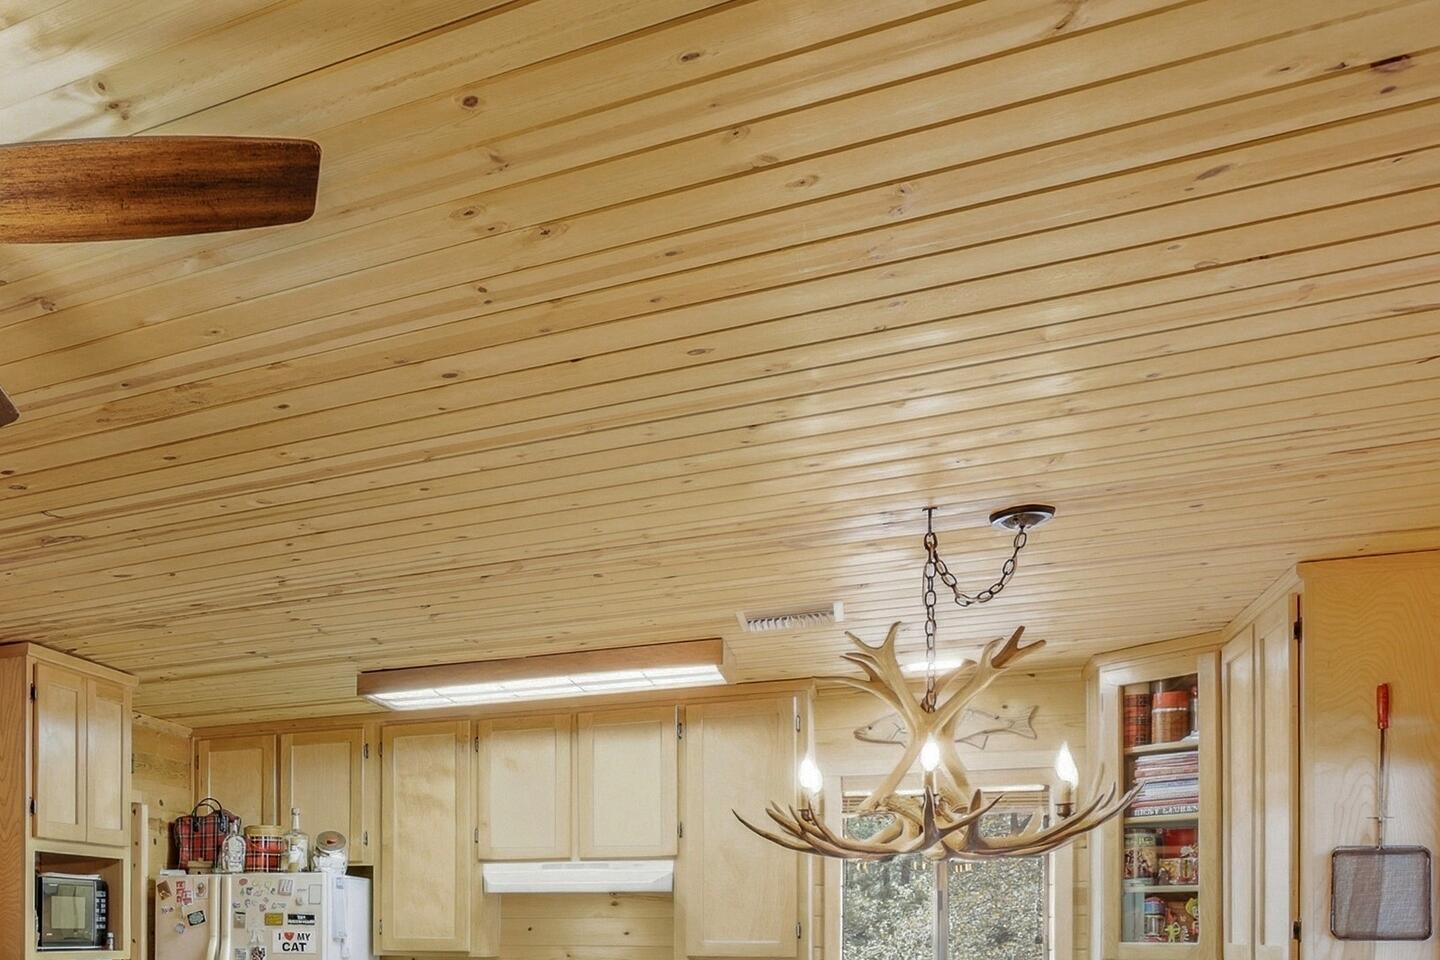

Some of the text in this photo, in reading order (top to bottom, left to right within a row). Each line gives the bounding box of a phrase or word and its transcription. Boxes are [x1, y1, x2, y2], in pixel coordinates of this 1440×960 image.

[277, 932, 311, 941] I MY
[281, 942, 307, 952] CAT
